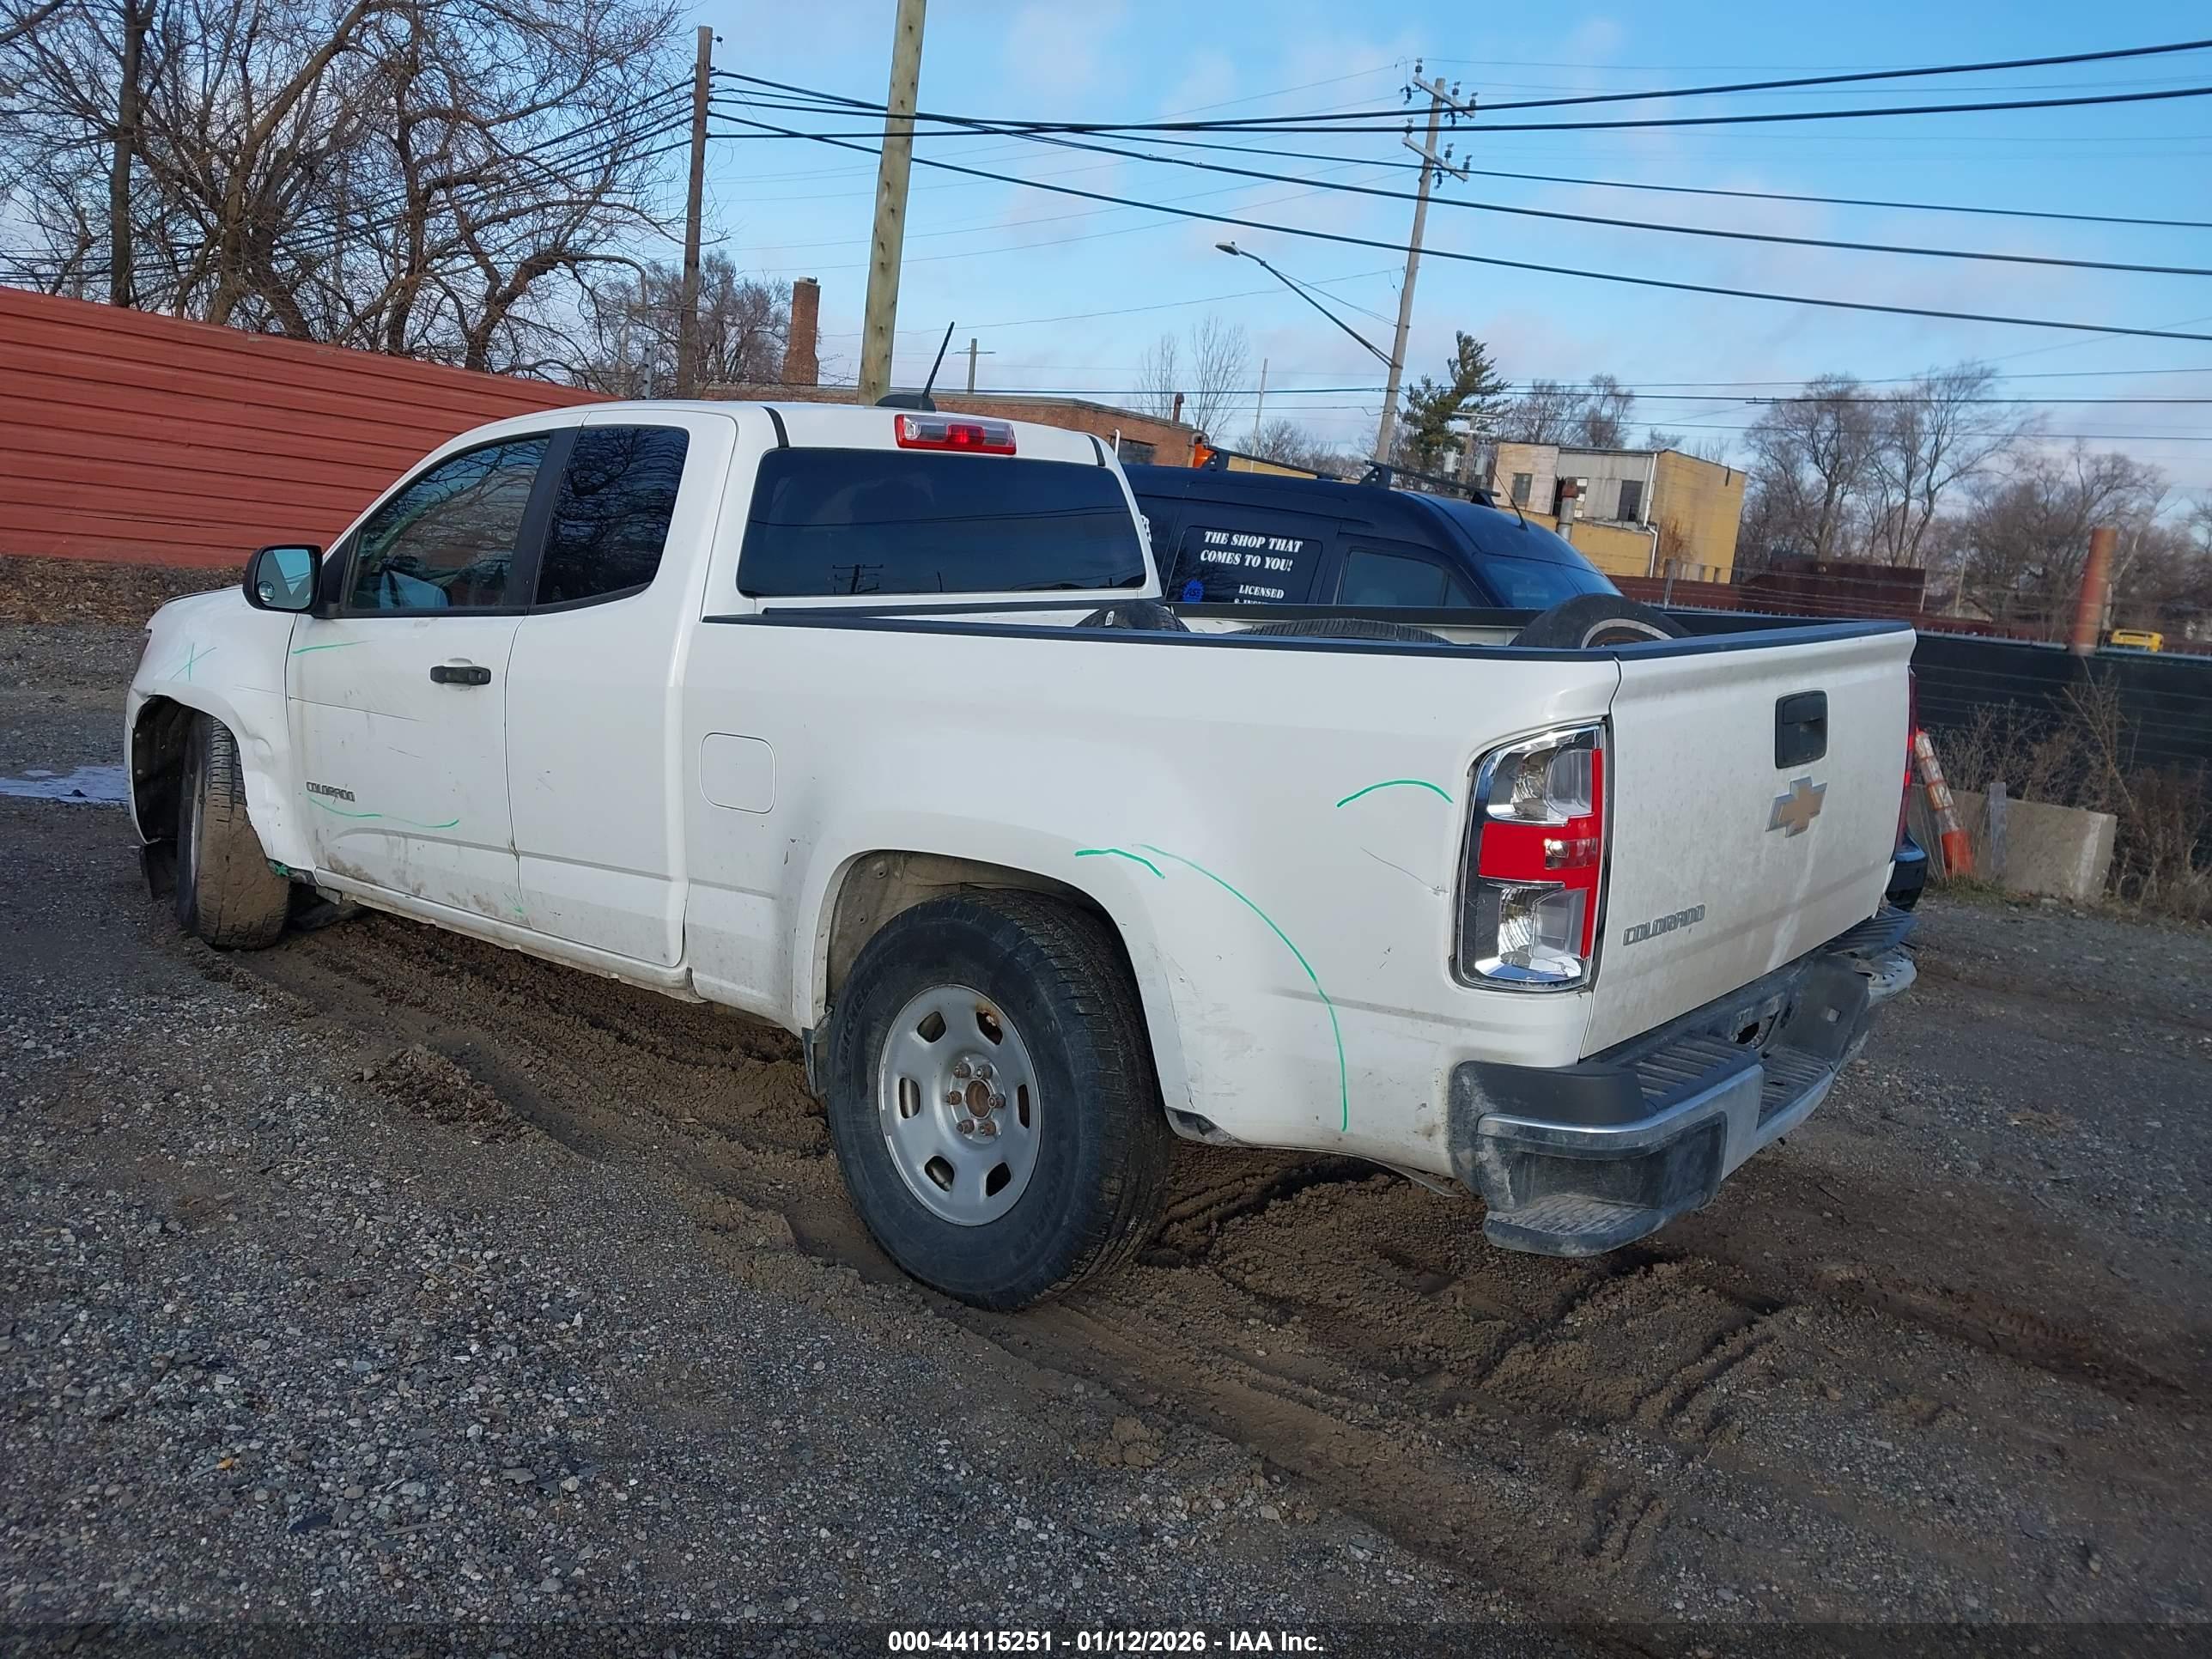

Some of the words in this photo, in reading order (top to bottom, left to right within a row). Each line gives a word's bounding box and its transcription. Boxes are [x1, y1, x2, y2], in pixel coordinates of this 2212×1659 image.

[1204, 531, 1229, 544] THE
[1231, 534, 1266, 549] SHOP
[1268, 538, 1304, 553] THAT
[1200, 550, 1242, 565] COMES
[1244, 555, 1261, 568] TO
[1264, 556, 1293, 572] YOU!
[1238, 584, 1285, 599] LICENSED
[306, 781, 356, 802] COLORADO
[1622, 903, 1705, 946] COLORADO
